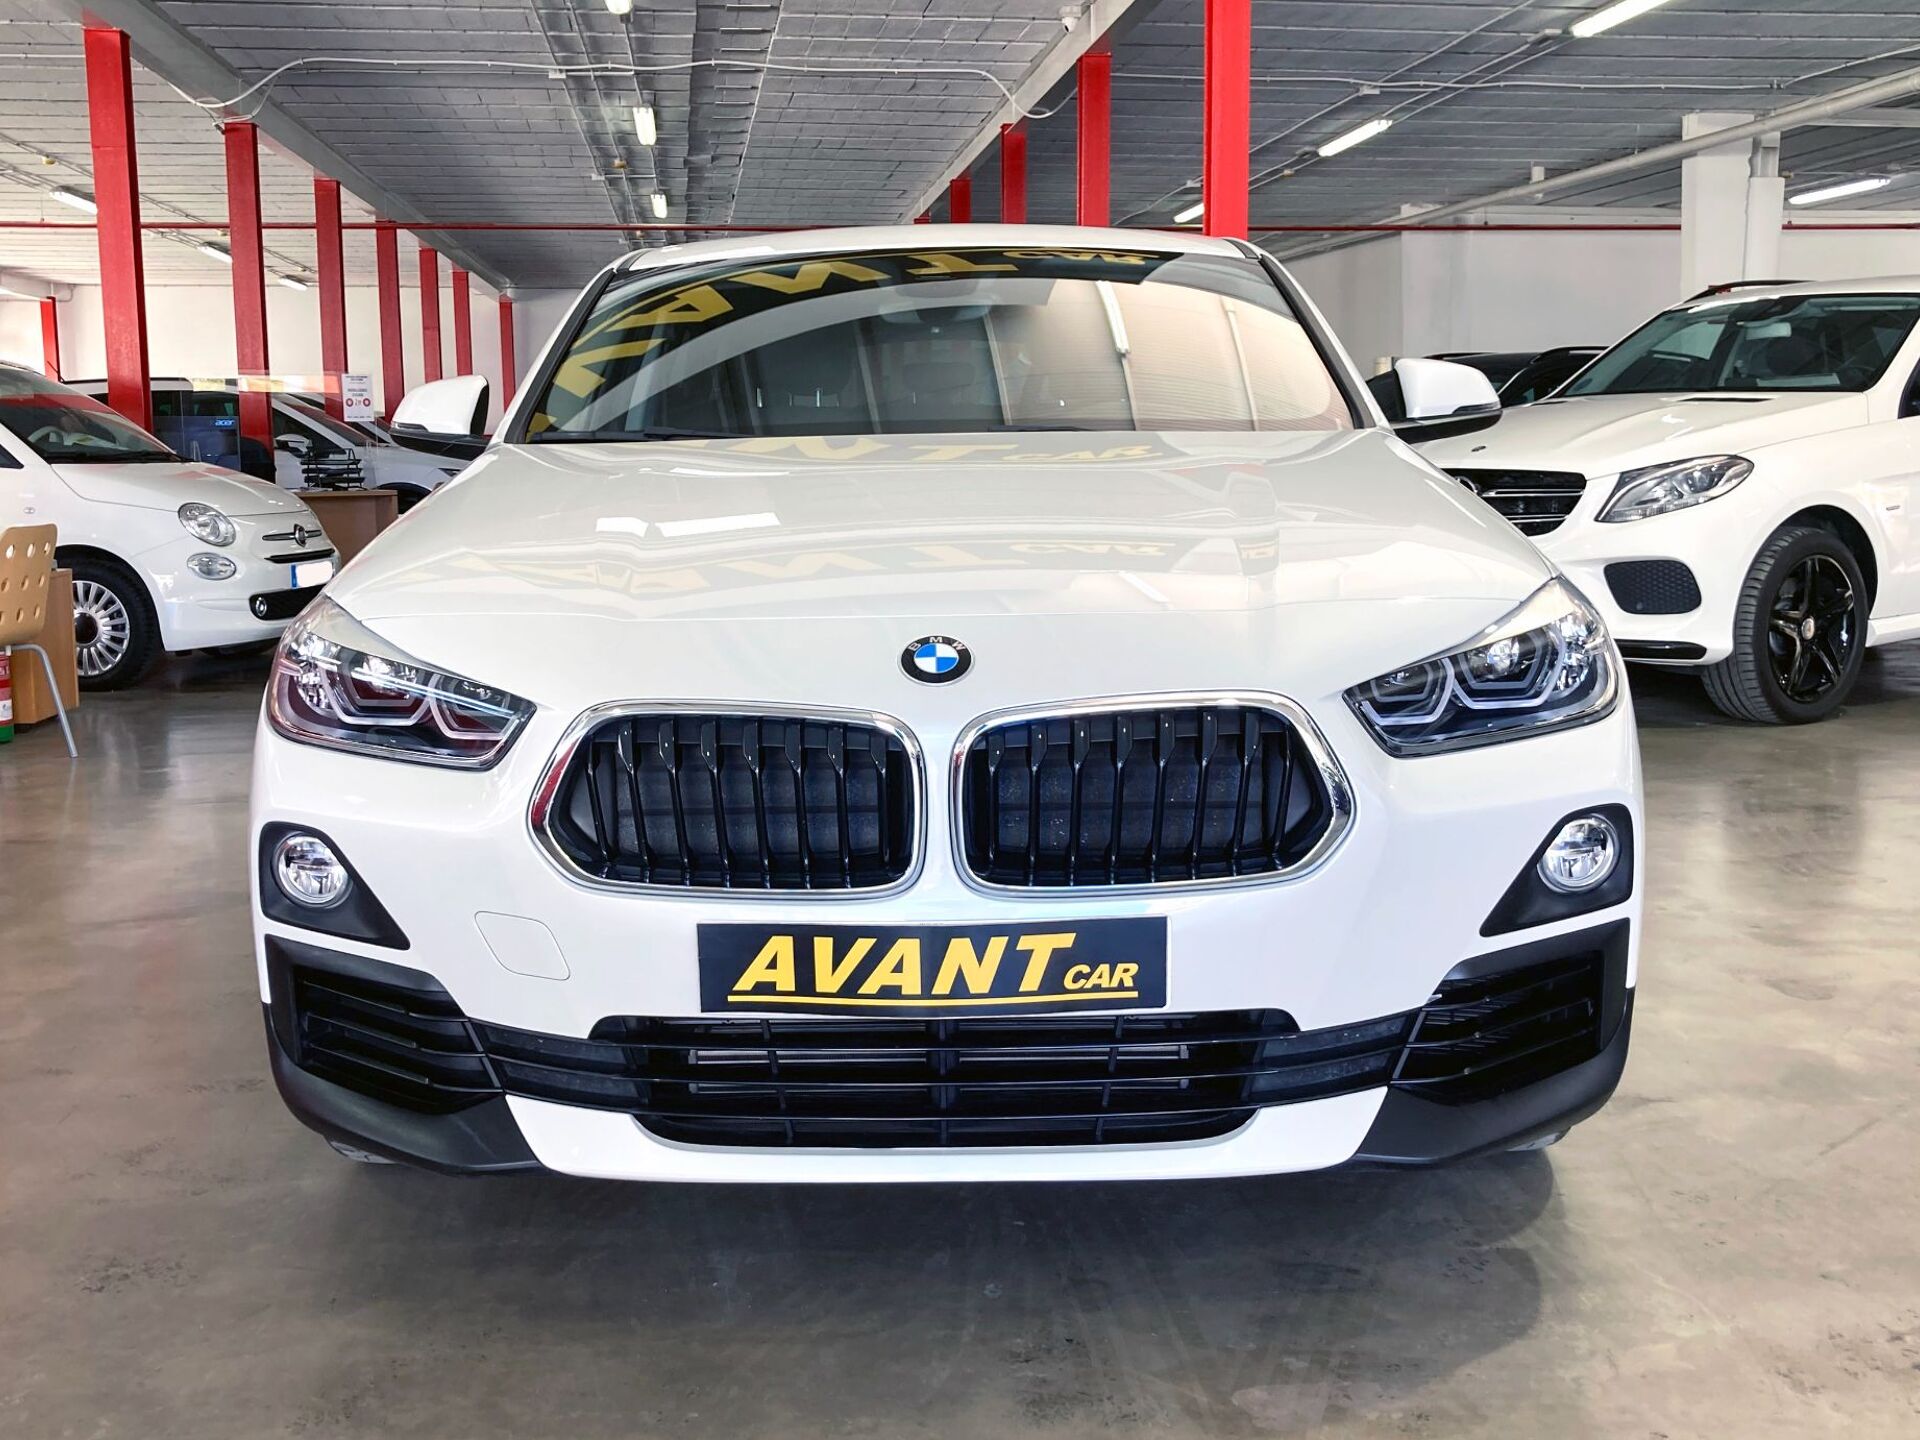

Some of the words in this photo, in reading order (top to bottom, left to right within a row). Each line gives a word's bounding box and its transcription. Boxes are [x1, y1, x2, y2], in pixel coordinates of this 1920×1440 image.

[907, 636, 966, 651] BMW
[732, 933, 1077, 995] AVANT
[1063, 962, 1139, 990] CAR
